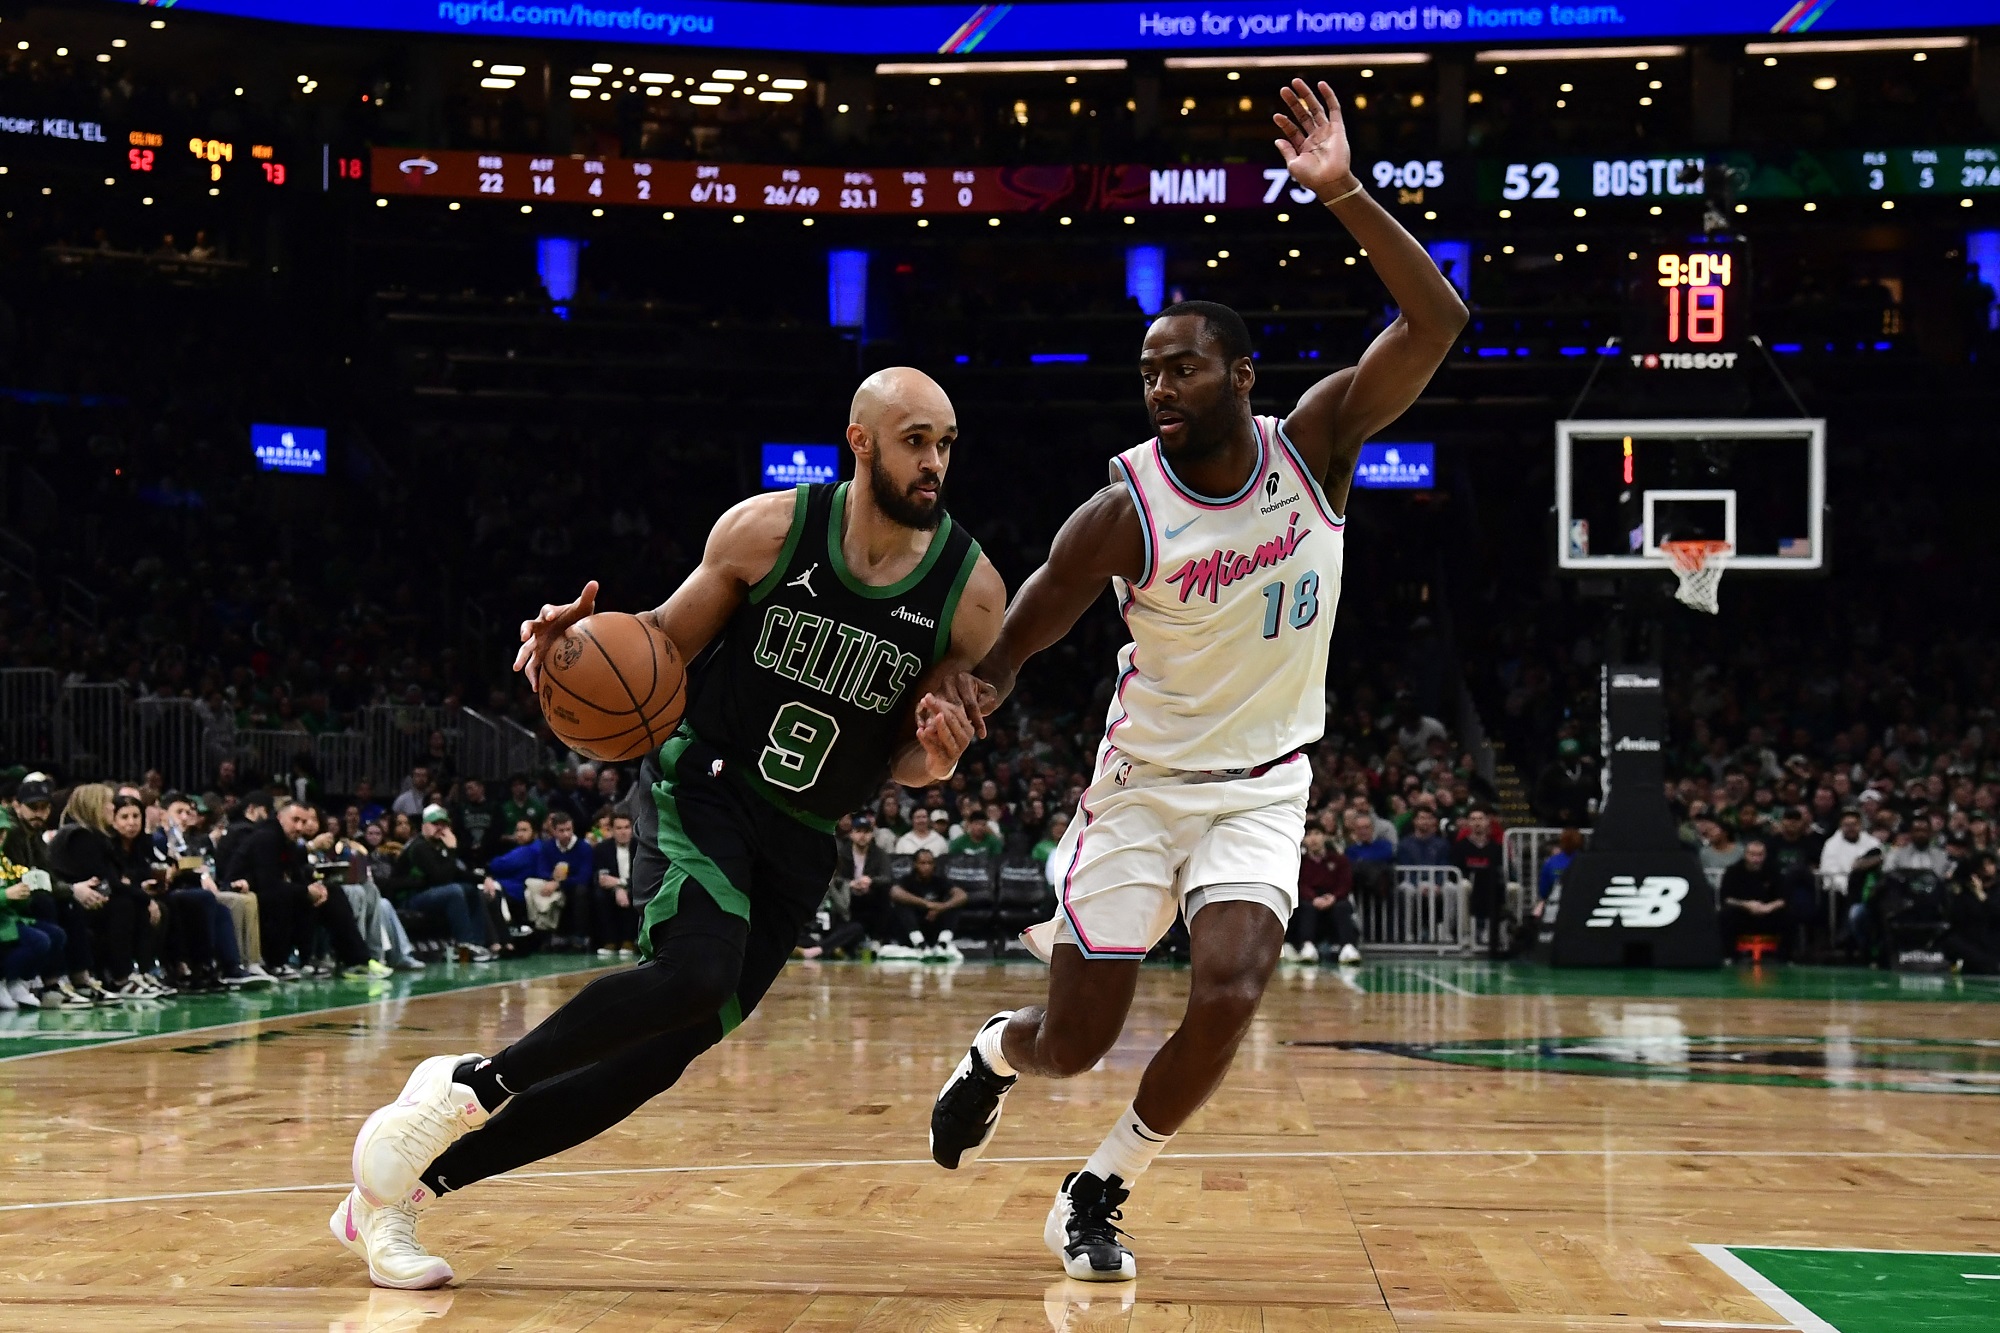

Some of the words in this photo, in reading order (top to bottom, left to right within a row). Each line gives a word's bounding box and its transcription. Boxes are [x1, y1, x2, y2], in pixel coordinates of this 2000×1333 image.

[439, 0, 714, 36] ngrid.com/hereforyou
[1140, 12, 1197, 36] Here
[1202, 10, 1234, 35] for
[1238, 14, 1292, 39] your
[1296, 9, 1366, 32] home
[1370, 7, 1417, 31] and
[1423, 6, 1462, 30] the
[1467, 6, 1543, 27] home
[1550, 4, 1626, 26] team.
[129, 148, 154, 171] 52
[189, 138, 232, 162] 9:04
[262, 163, 285, 185] 73
[339, 158, 362, 179] 18
[1372, 160, 1445, 188] 9:05
[1869, 169, 1884, 190] 3
[1919, 167, 1934, 188] 5
[479, 173, 504, 193] 22
[532, 175, 555, 195] 14
[588, 178, 603, 198] 4
[638, 180, 651, 200] 2
[690, 182, 737, 203] 6/13
[764, 185, 820, 206] 26/49
[840, 189, 877, 208] 53.1
[910, 188, 924, 207] 5
[957, 187, 973, 207] 0
[1150, 168, 1226, 205] MIAMI
[1503, 162, 1560, 201] 52
[1658, 253, 1731, 287] 9:04
[1669, 286, 1723, 342] 18
[1660, 353, 1738, 369] TISSOT
[1260, 493, 1300, 515] Robinhood
[1165, 511, 1311, 604] Miami
[891, 606, 935, 629] Amica
[1262, 569, 1319, 640] 18
[754, 605, 921, 713] CELTICS
[758, 701, 840, 792] 9
